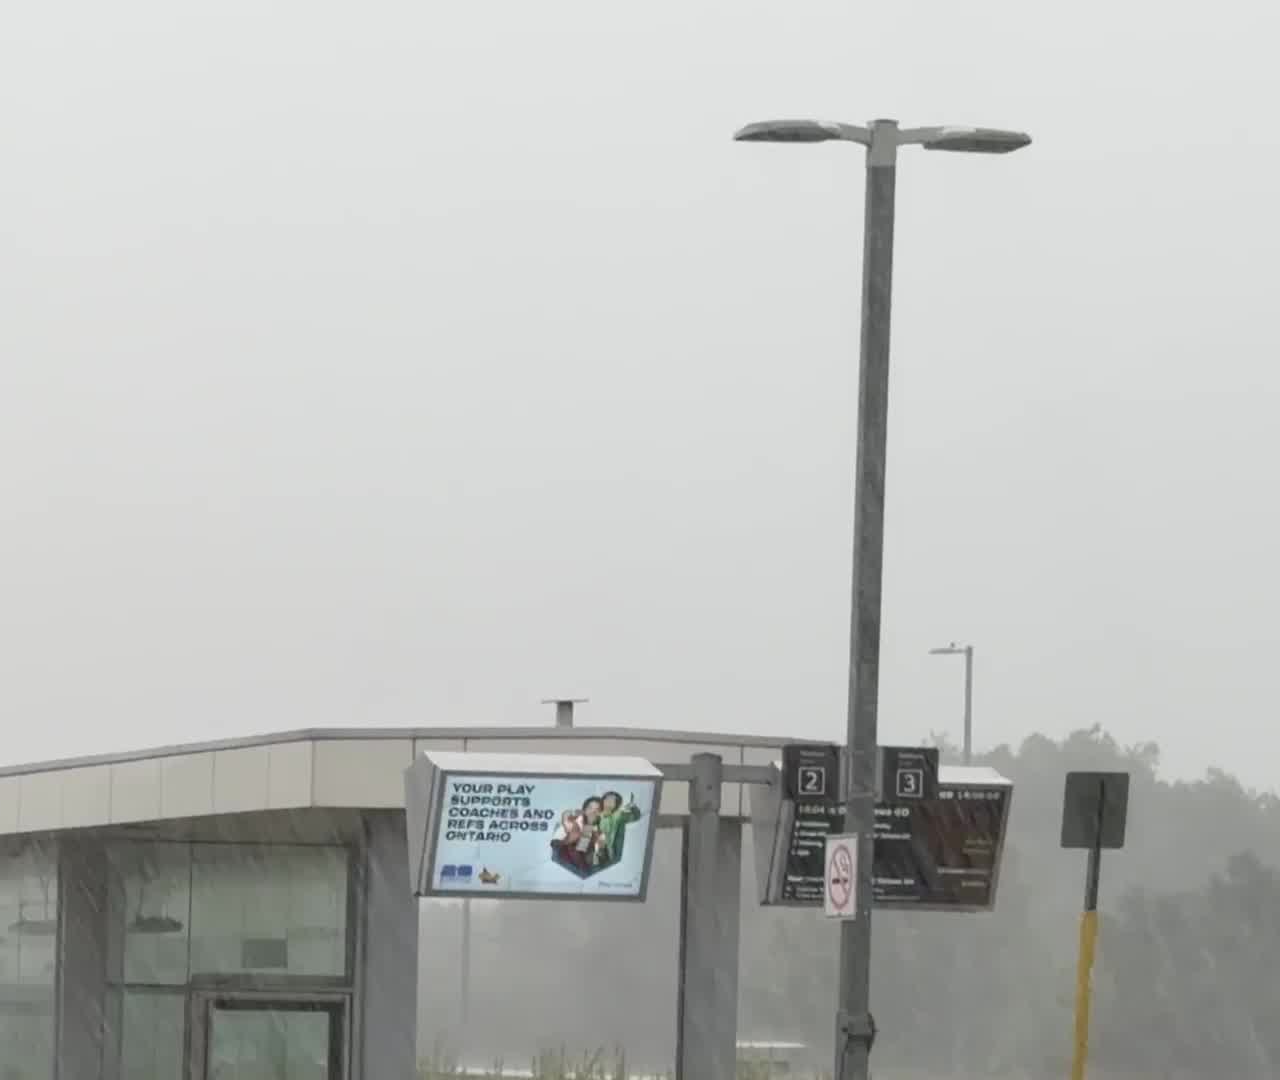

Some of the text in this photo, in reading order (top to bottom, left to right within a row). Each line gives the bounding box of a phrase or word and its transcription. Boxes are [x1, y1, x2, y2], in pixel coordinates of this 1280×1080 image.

[804, 771, 817, 791] 2
[903, 774, 916, 793] 3
[452, 783, 535, 794] YOUR PLAY
[450, 796, 531, 807] SUPPORTS
[448, 807, 555, 820] COACHES AND
[446, 819, 549, 832] REFS ACROSS
[445, 831, 512, 842] ONTARIO
